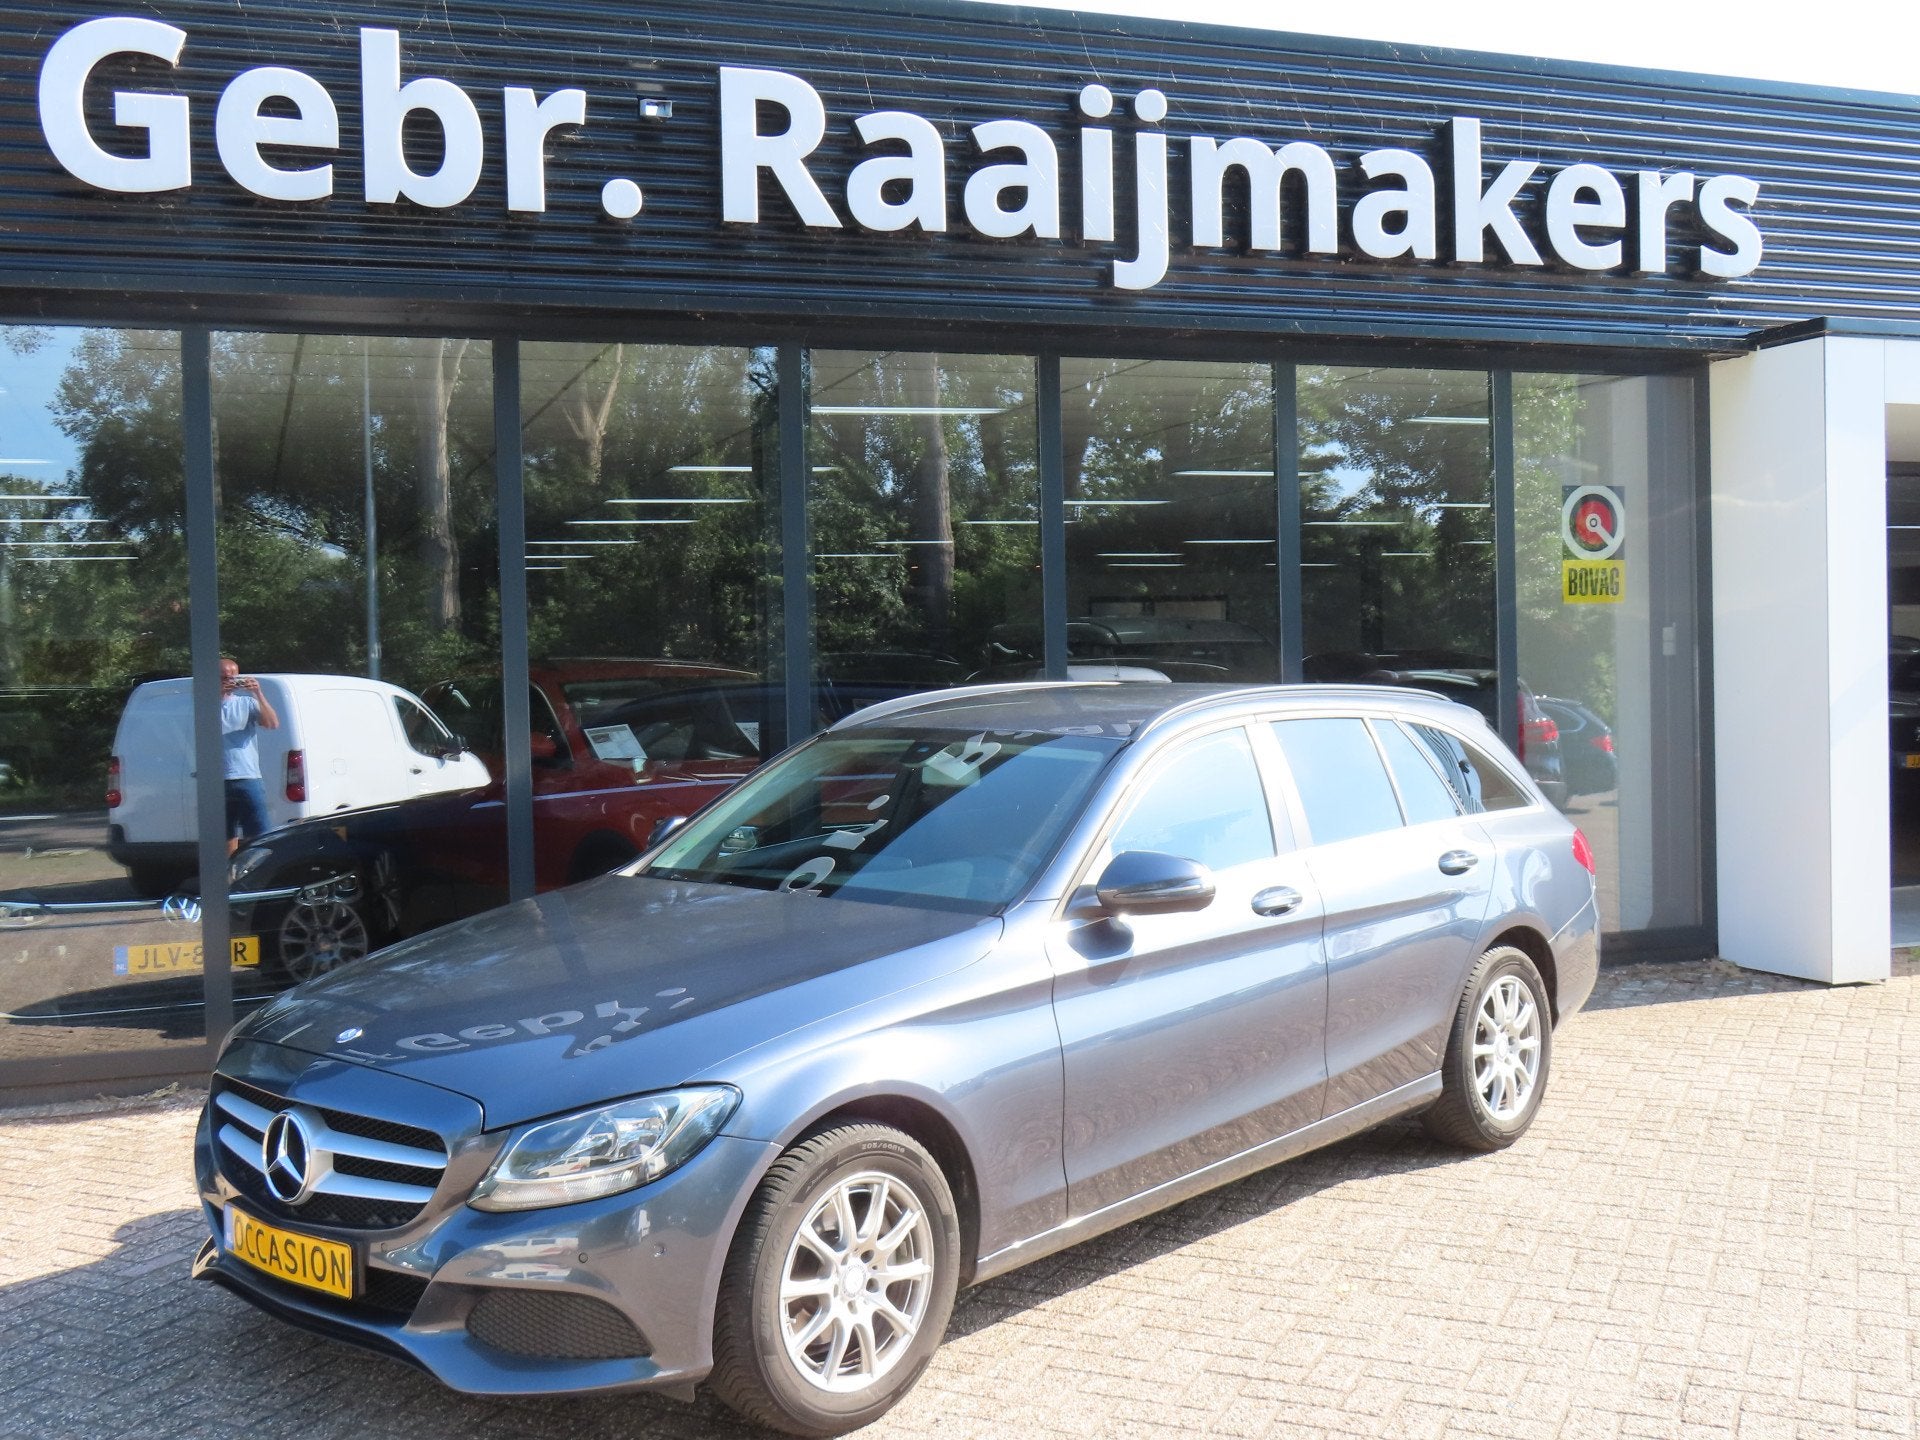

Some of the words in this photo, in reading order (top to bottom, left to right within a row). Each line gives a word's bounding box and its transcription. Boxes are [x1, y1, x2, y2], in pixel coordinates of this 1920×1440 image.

[38, 16, 644, 220] Gebr.
[719, 66, 1764, 290] Raaijmakers
[1568, 567, 1620, 597] BOVAG
[233, 1214, 347, 1290] OCCASION
